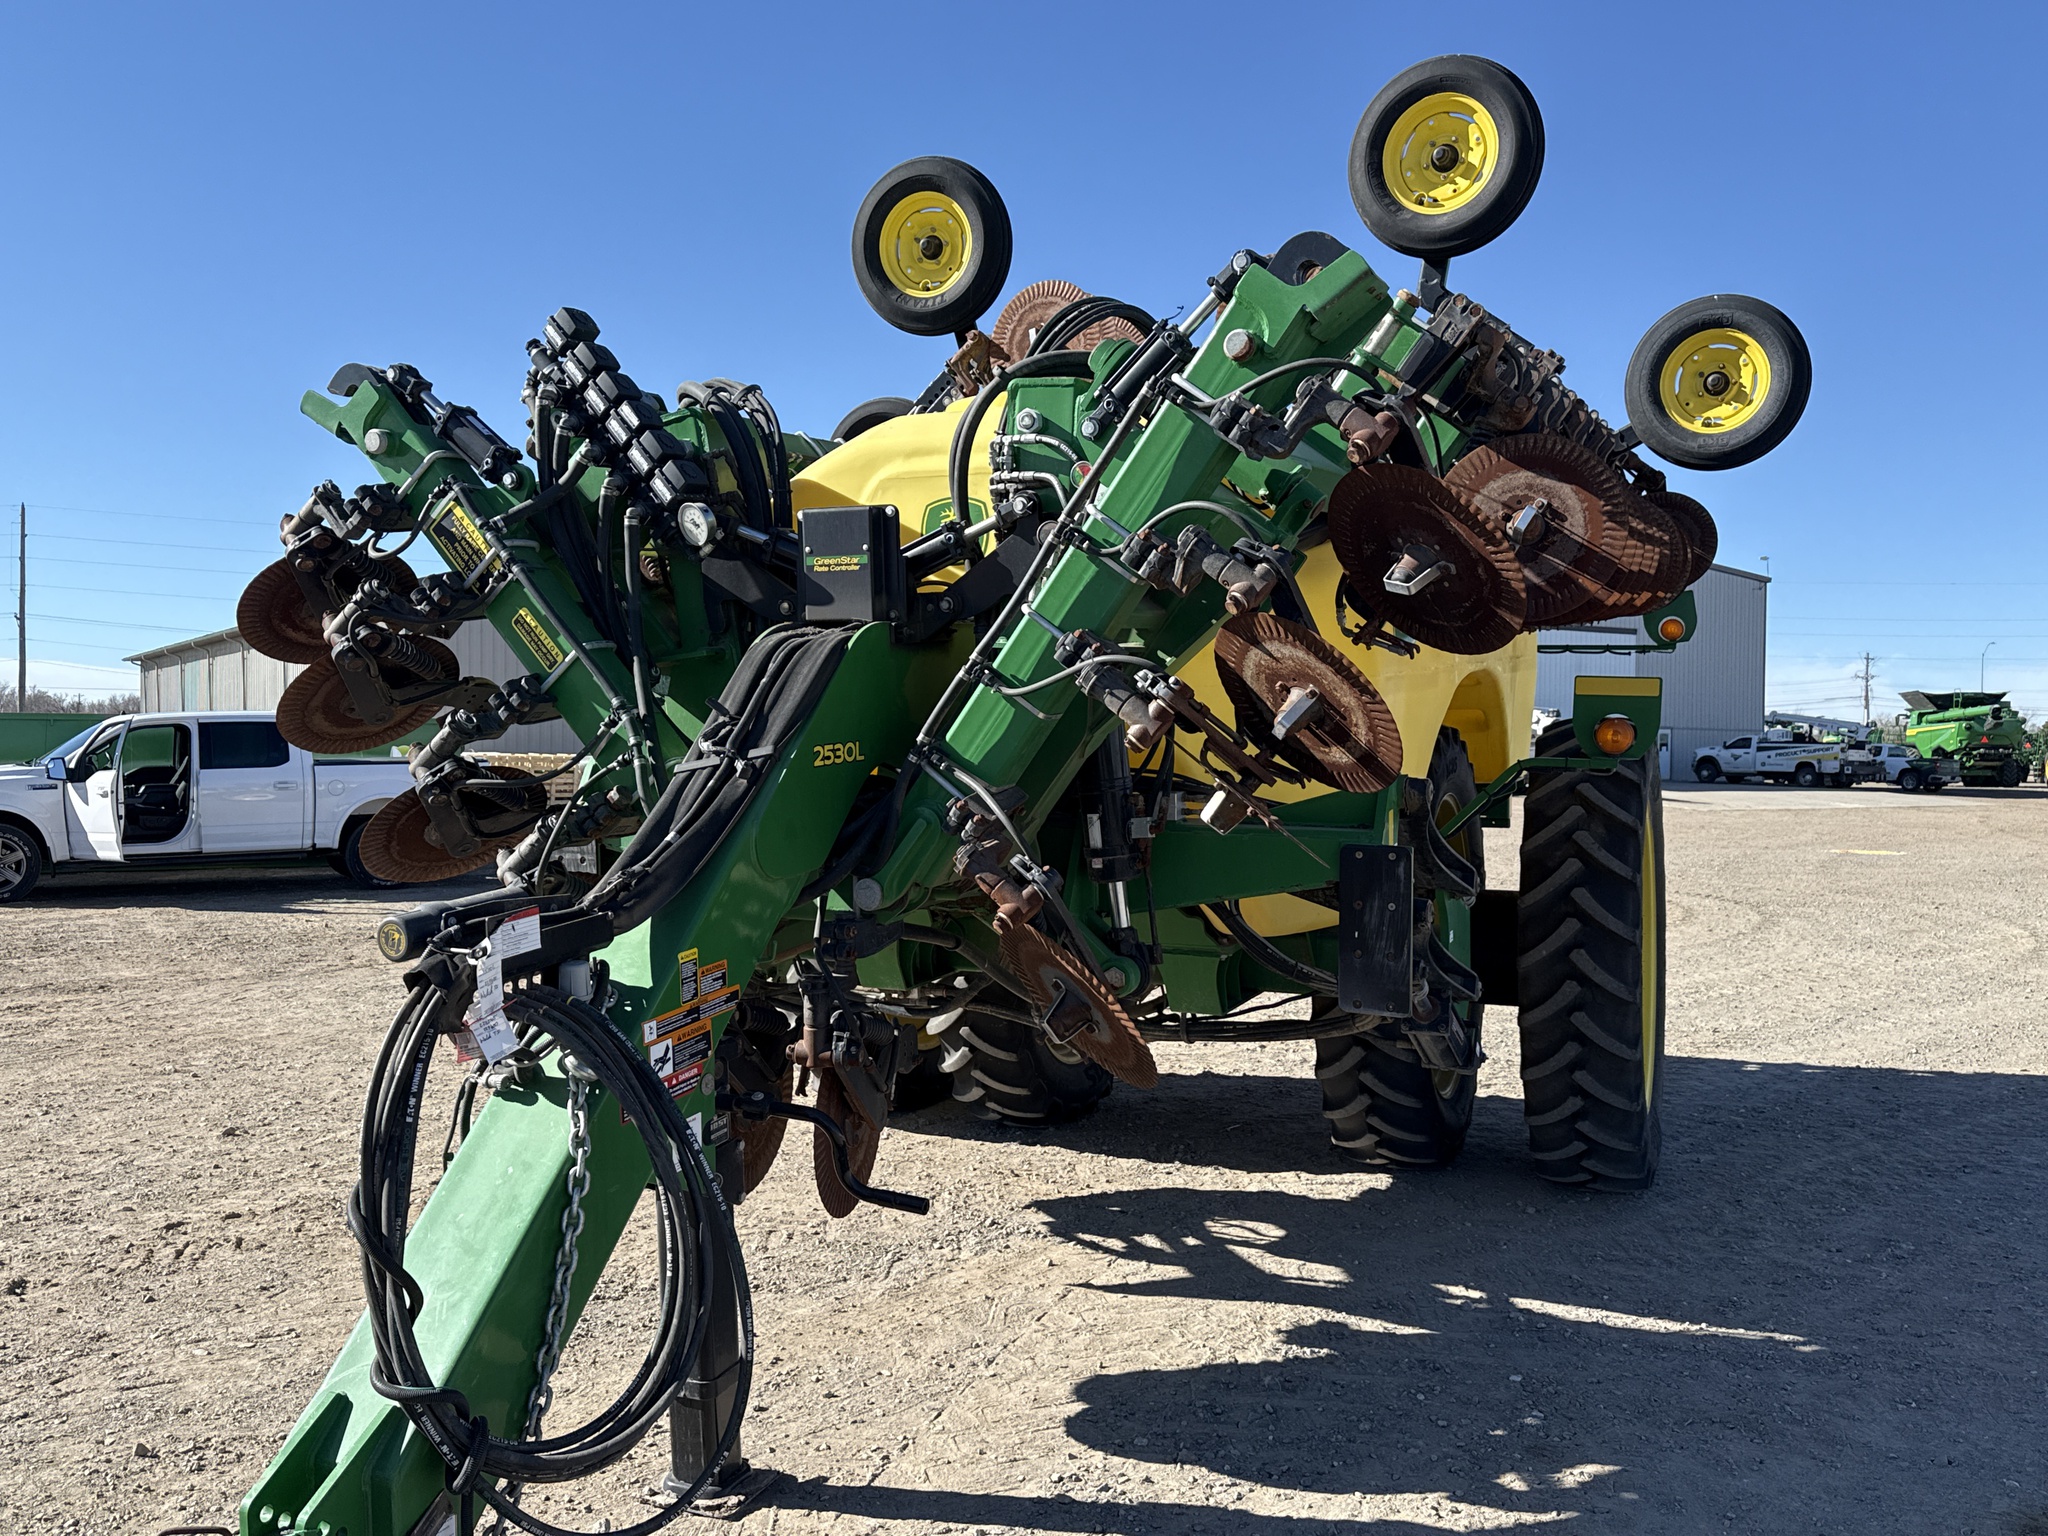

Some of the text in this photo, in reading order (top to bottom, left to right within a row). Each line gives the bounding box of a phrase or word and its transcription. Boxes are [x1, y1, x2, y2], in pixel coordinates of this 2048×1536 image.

[450, 526, 488, 574] AND MAIN WINS
[451, 515, 496, 573] FULLY RAISE CEER
[452, 542, 475, 570] PRIOR TO
[465, 522, 497, 563] CAUTI
[438, 535, 480, 588] ACTIVATING LOS
[813, 556, 861, 565] GreenStar
[516, 623, 531, 642] DAMAGE
[529, 641, 538, 651] MAY
[517, 616, 524, 624] DO
[522, 622, 531, 632] NOT
[529, 631, 538, 642] RUN
[536, 641, 547, 654] PUMP
[527, 617, 560, 658] CAUTION
[813, 741, 865, 767] 2530L
[1806, 746, 1834, 755] SUPPORT
[705, 962, 726, 973] WARNING
[681, 1023, 708, 1040] WARNING
[410, 1062, 423, 1093] WINNER
[419, 1027, 434, 1058] EC215-10
[678, 1067, 698, 1082] DANGER
[697, 1152, 713, 1179] WINNER
[710, 1181, 727, 1211] EC215-10
[420, 1414, 442, 1443] WINNER
[690, 1476, 713, 1502] WINNER
